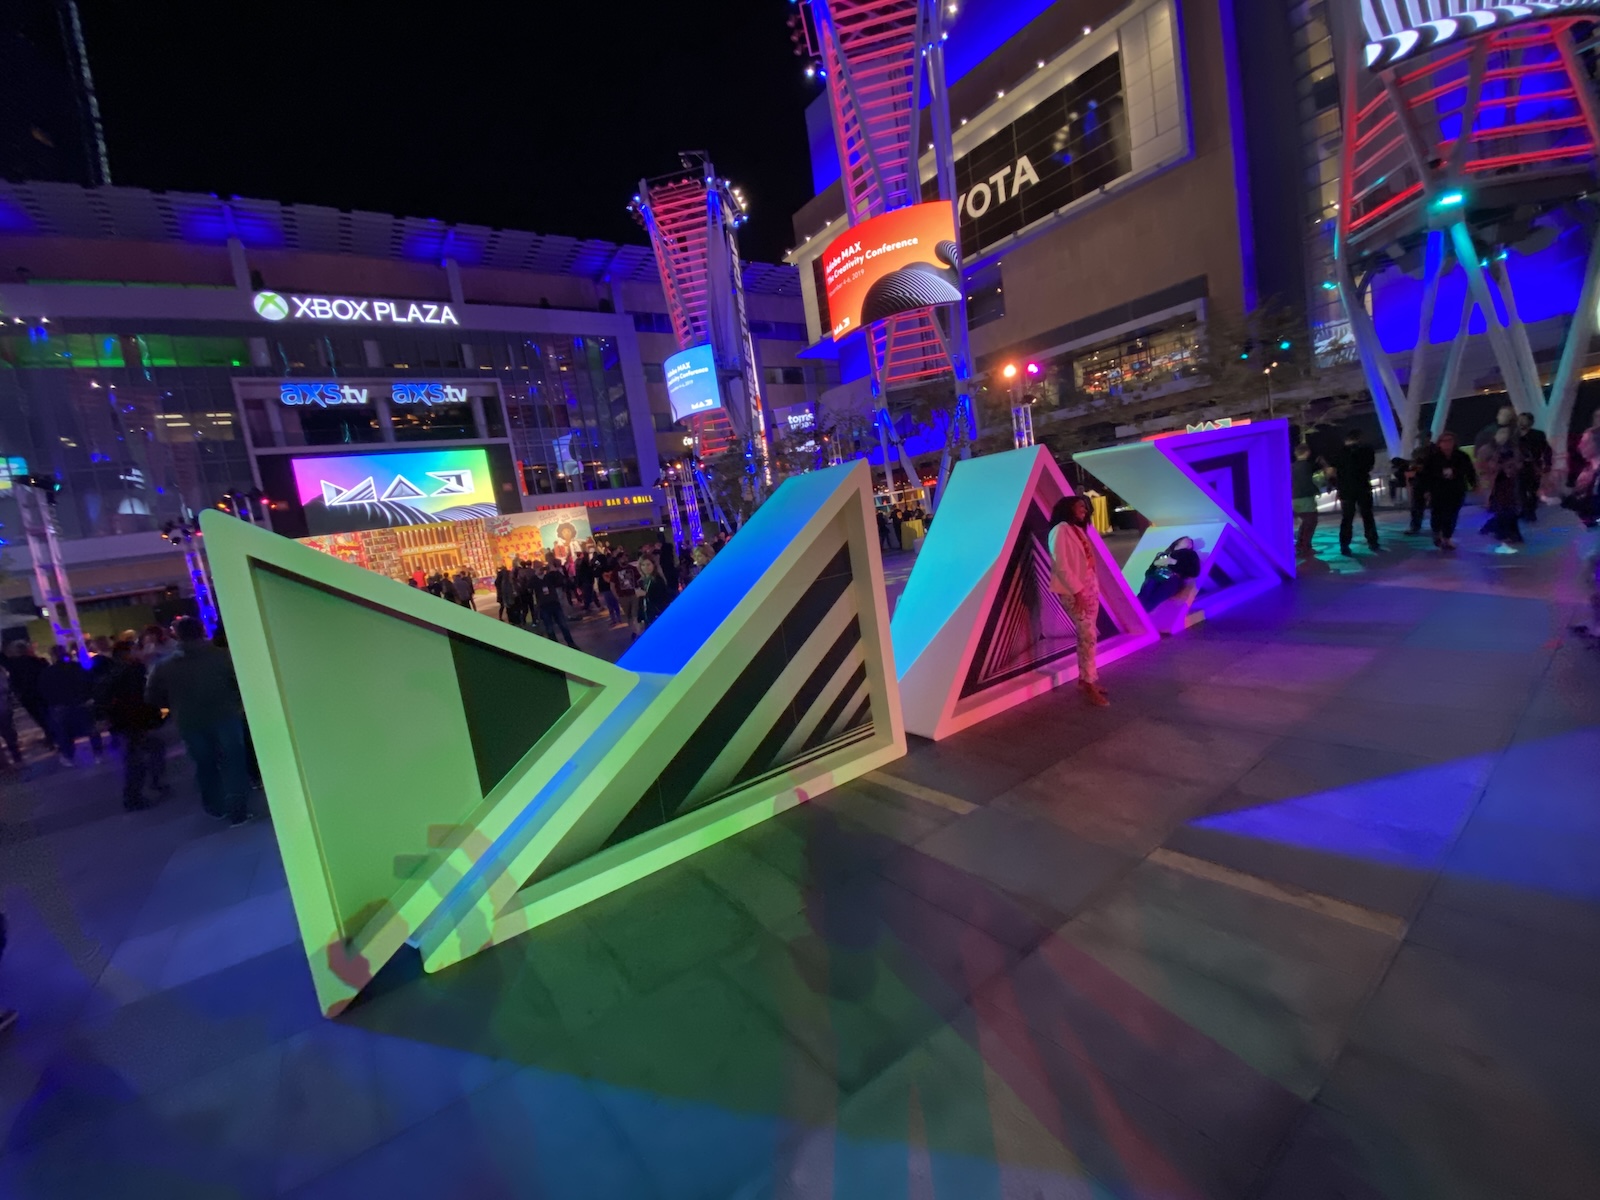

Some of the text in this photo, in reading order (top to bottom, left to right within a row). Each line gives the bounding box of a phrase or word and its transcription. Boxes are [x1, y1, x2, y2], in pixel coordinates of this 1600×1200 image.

[833, 255, 864, 279] Creativity
[865, 237, 919, 260] Conference
[841, 241, 862, 261] MAX
[851, 268, 865, 281] 2019
[292, 297, 460, 326] XBOX PLAZA
[606, 498, 621, 506] BAR
[624, 497, 630, 505] &
[632, 495, 653, 504] GRILL
